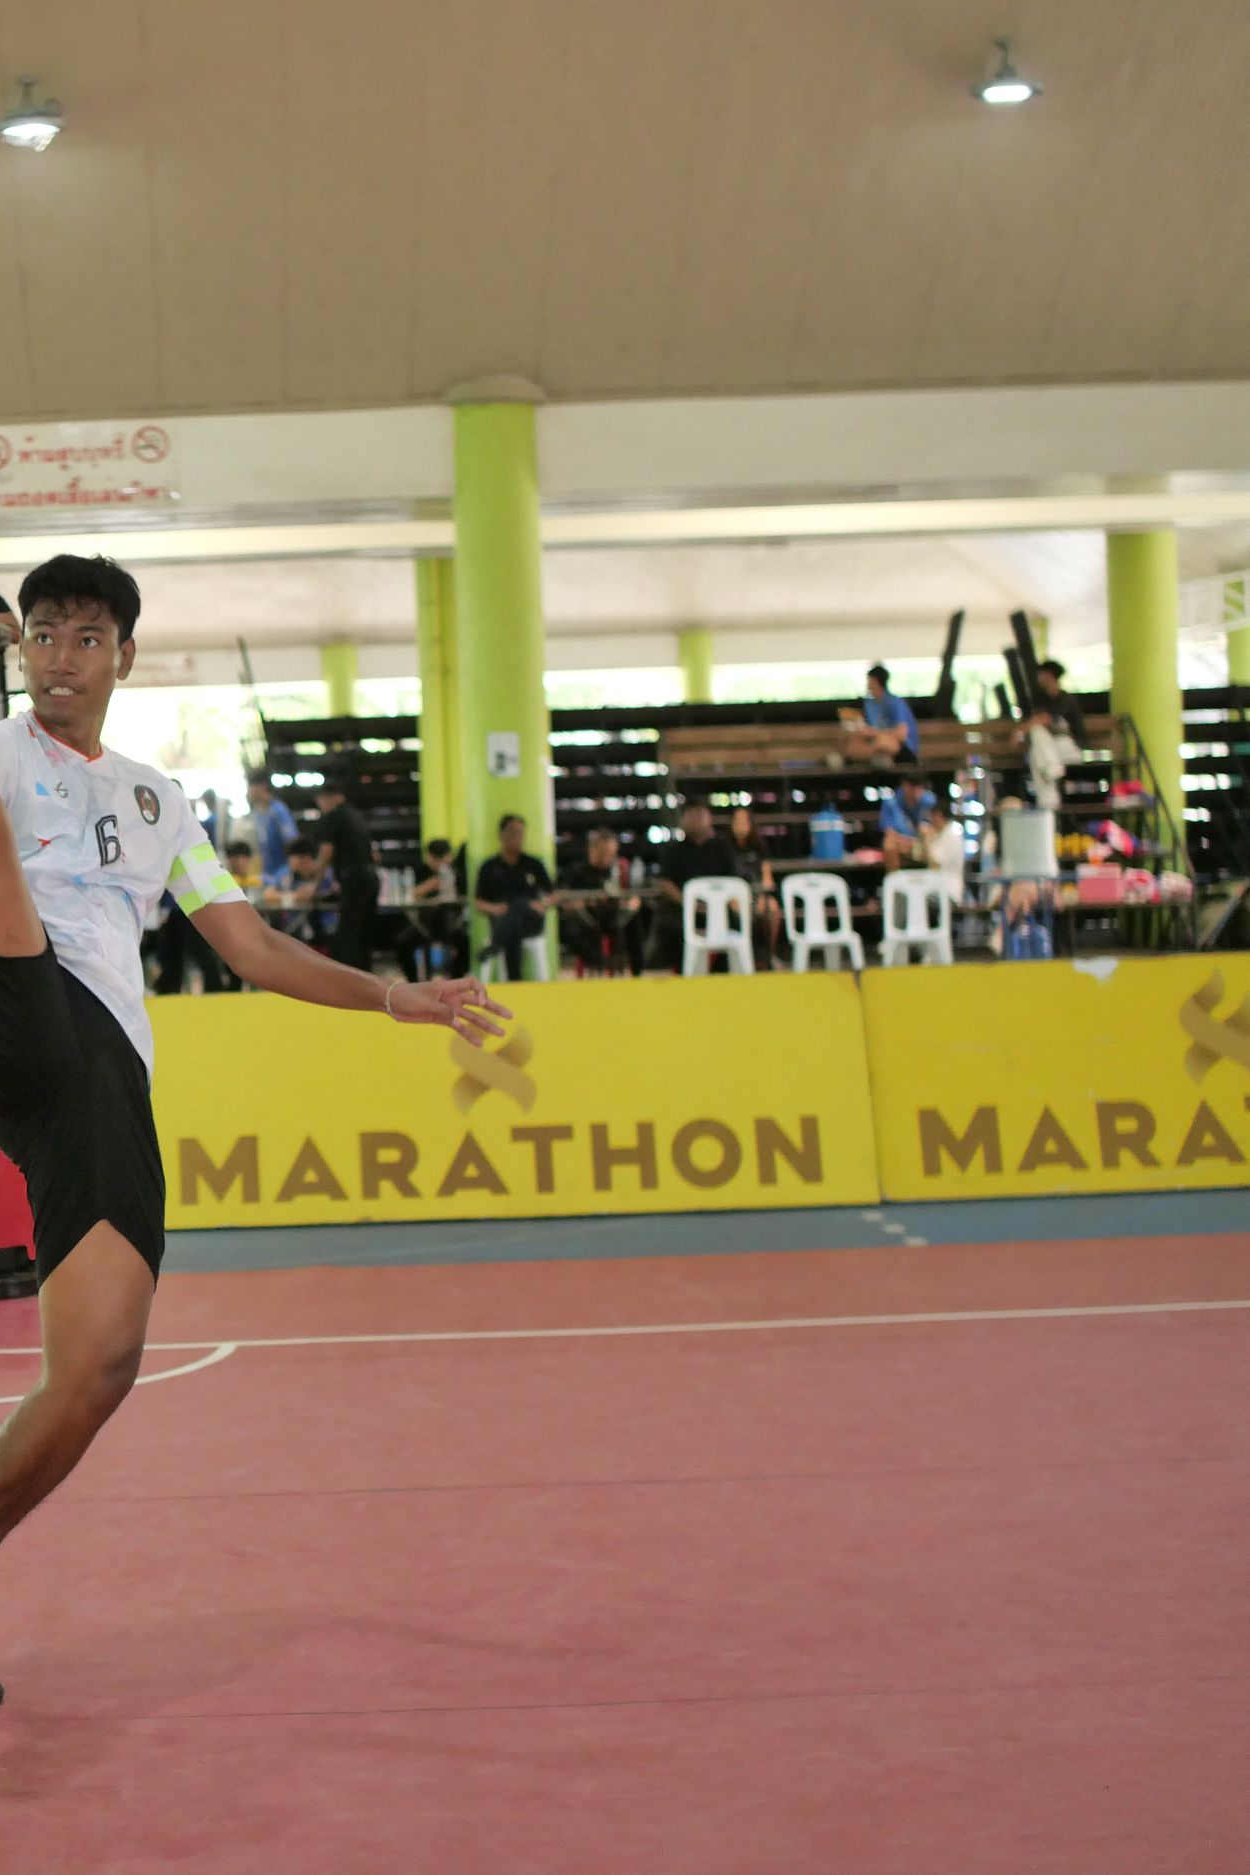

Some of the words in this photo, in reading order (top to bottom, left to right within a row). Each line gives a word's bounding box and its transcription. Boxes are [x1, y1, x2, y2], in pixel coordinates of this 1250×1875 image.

[94, 814, 122, 867] 6
[177, 1114, 824, 1207] MARATHON
[917, 1095, 1250, 1177] MARA
